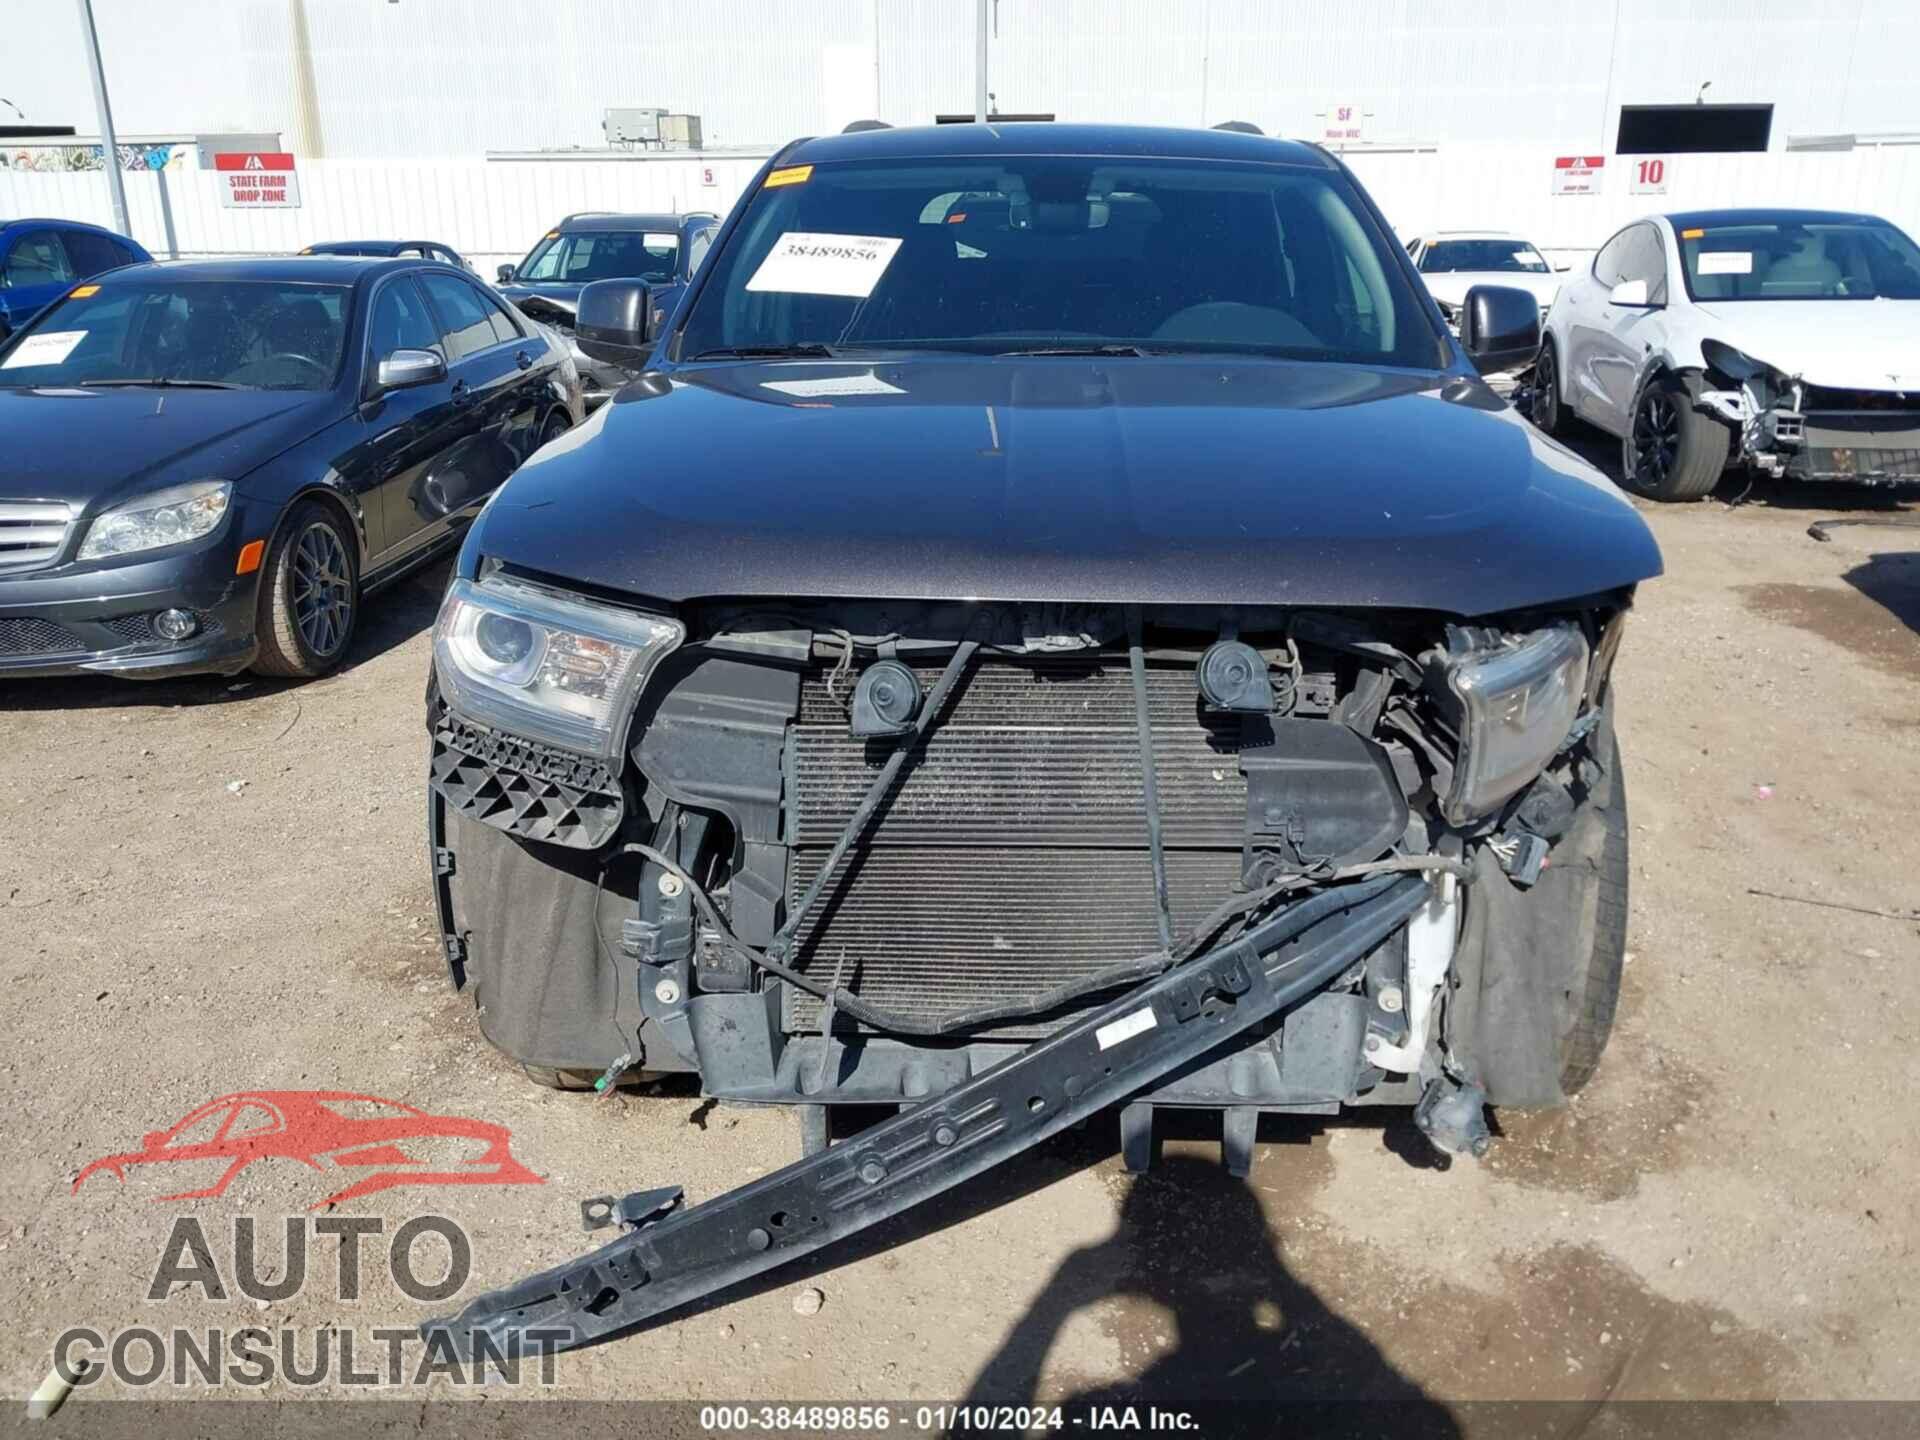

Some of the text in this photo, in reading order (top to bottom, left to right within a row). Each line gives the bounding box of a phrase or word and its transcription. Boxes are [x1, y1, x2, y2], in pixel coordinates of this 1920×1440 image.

[704, 168, 713, 183] 5
[1638, 160, 1664, 184] 10
[229, 175, 287, 188] STATE FARM
[233, 189, 287, 202] DROP ZONE
[781, 244, 878, 262] 38489856
